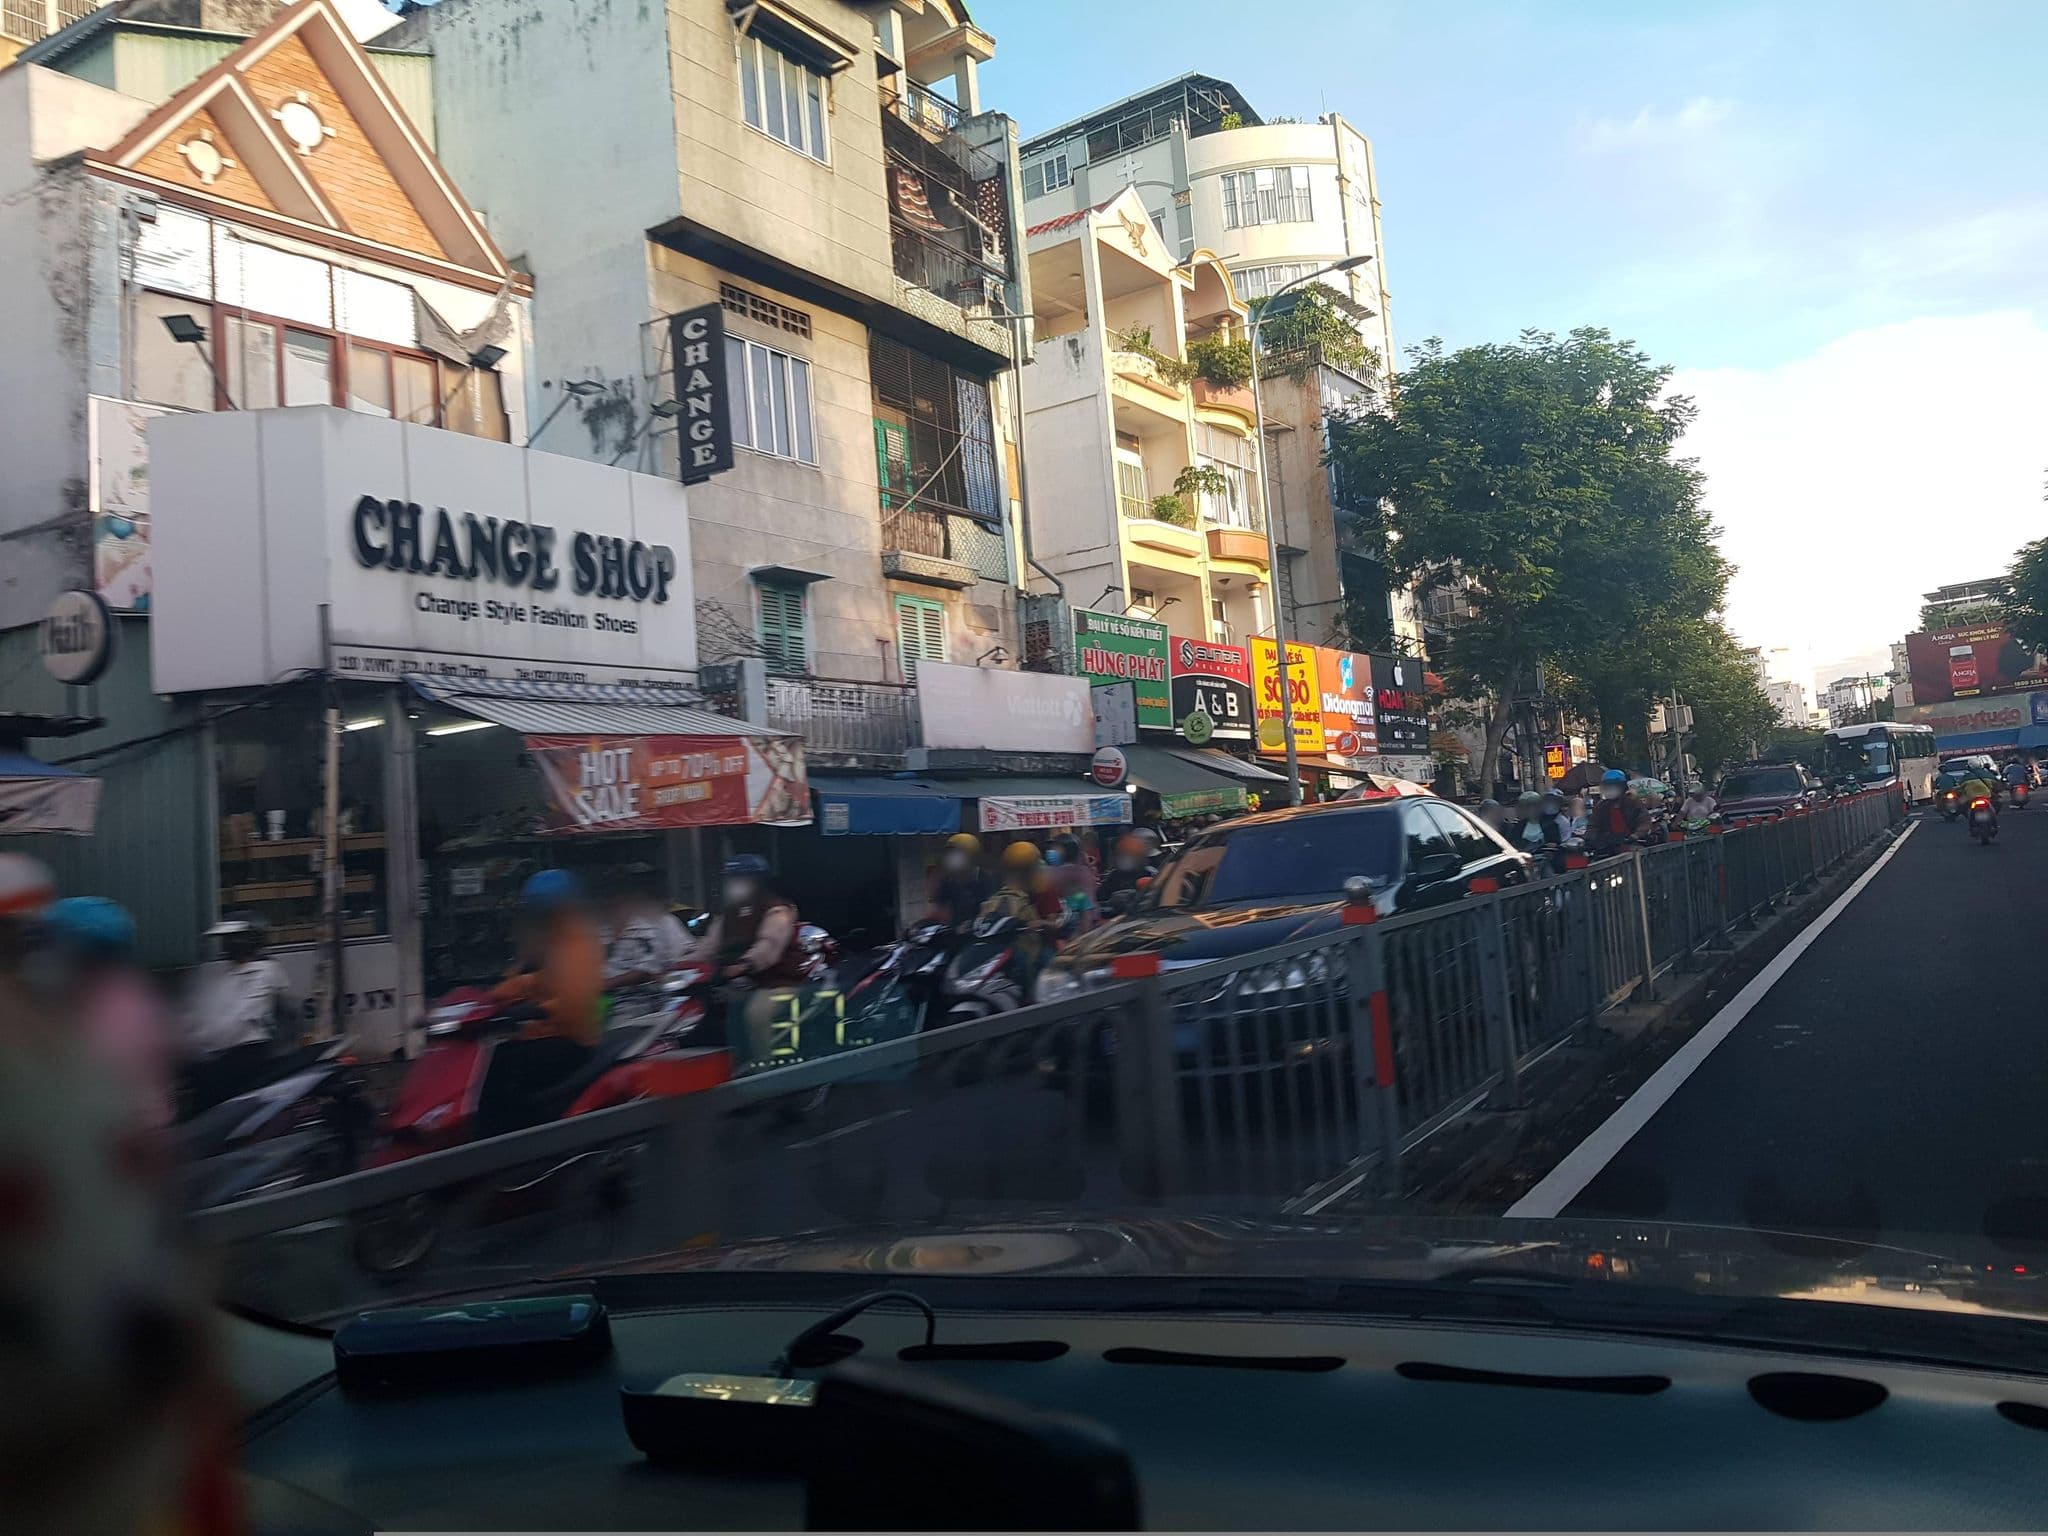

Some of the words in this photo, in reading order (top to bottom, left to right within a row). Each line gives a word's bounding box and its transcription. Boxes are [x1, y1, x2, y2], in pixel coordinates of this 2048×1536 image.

[682, 317, 718, 468] CHANGE
[353, 494, 560, 592] CHANGE
[572, 530, 677, 604] SHOP
[415, 592, 480, 622] Change
[484, 600, 527, 625] Style
[530, 604, 588, 629] Fashion
[594, 612, 638, 634] Shoes
[1082, 640, 1127, 677] HÙNG
[1128, 648, 1166, 682] PHÁT
[1226, 692, 1239, 718] B
[580, 748, 634, 787] HOT
[574, 782, 641, 825] SALE
